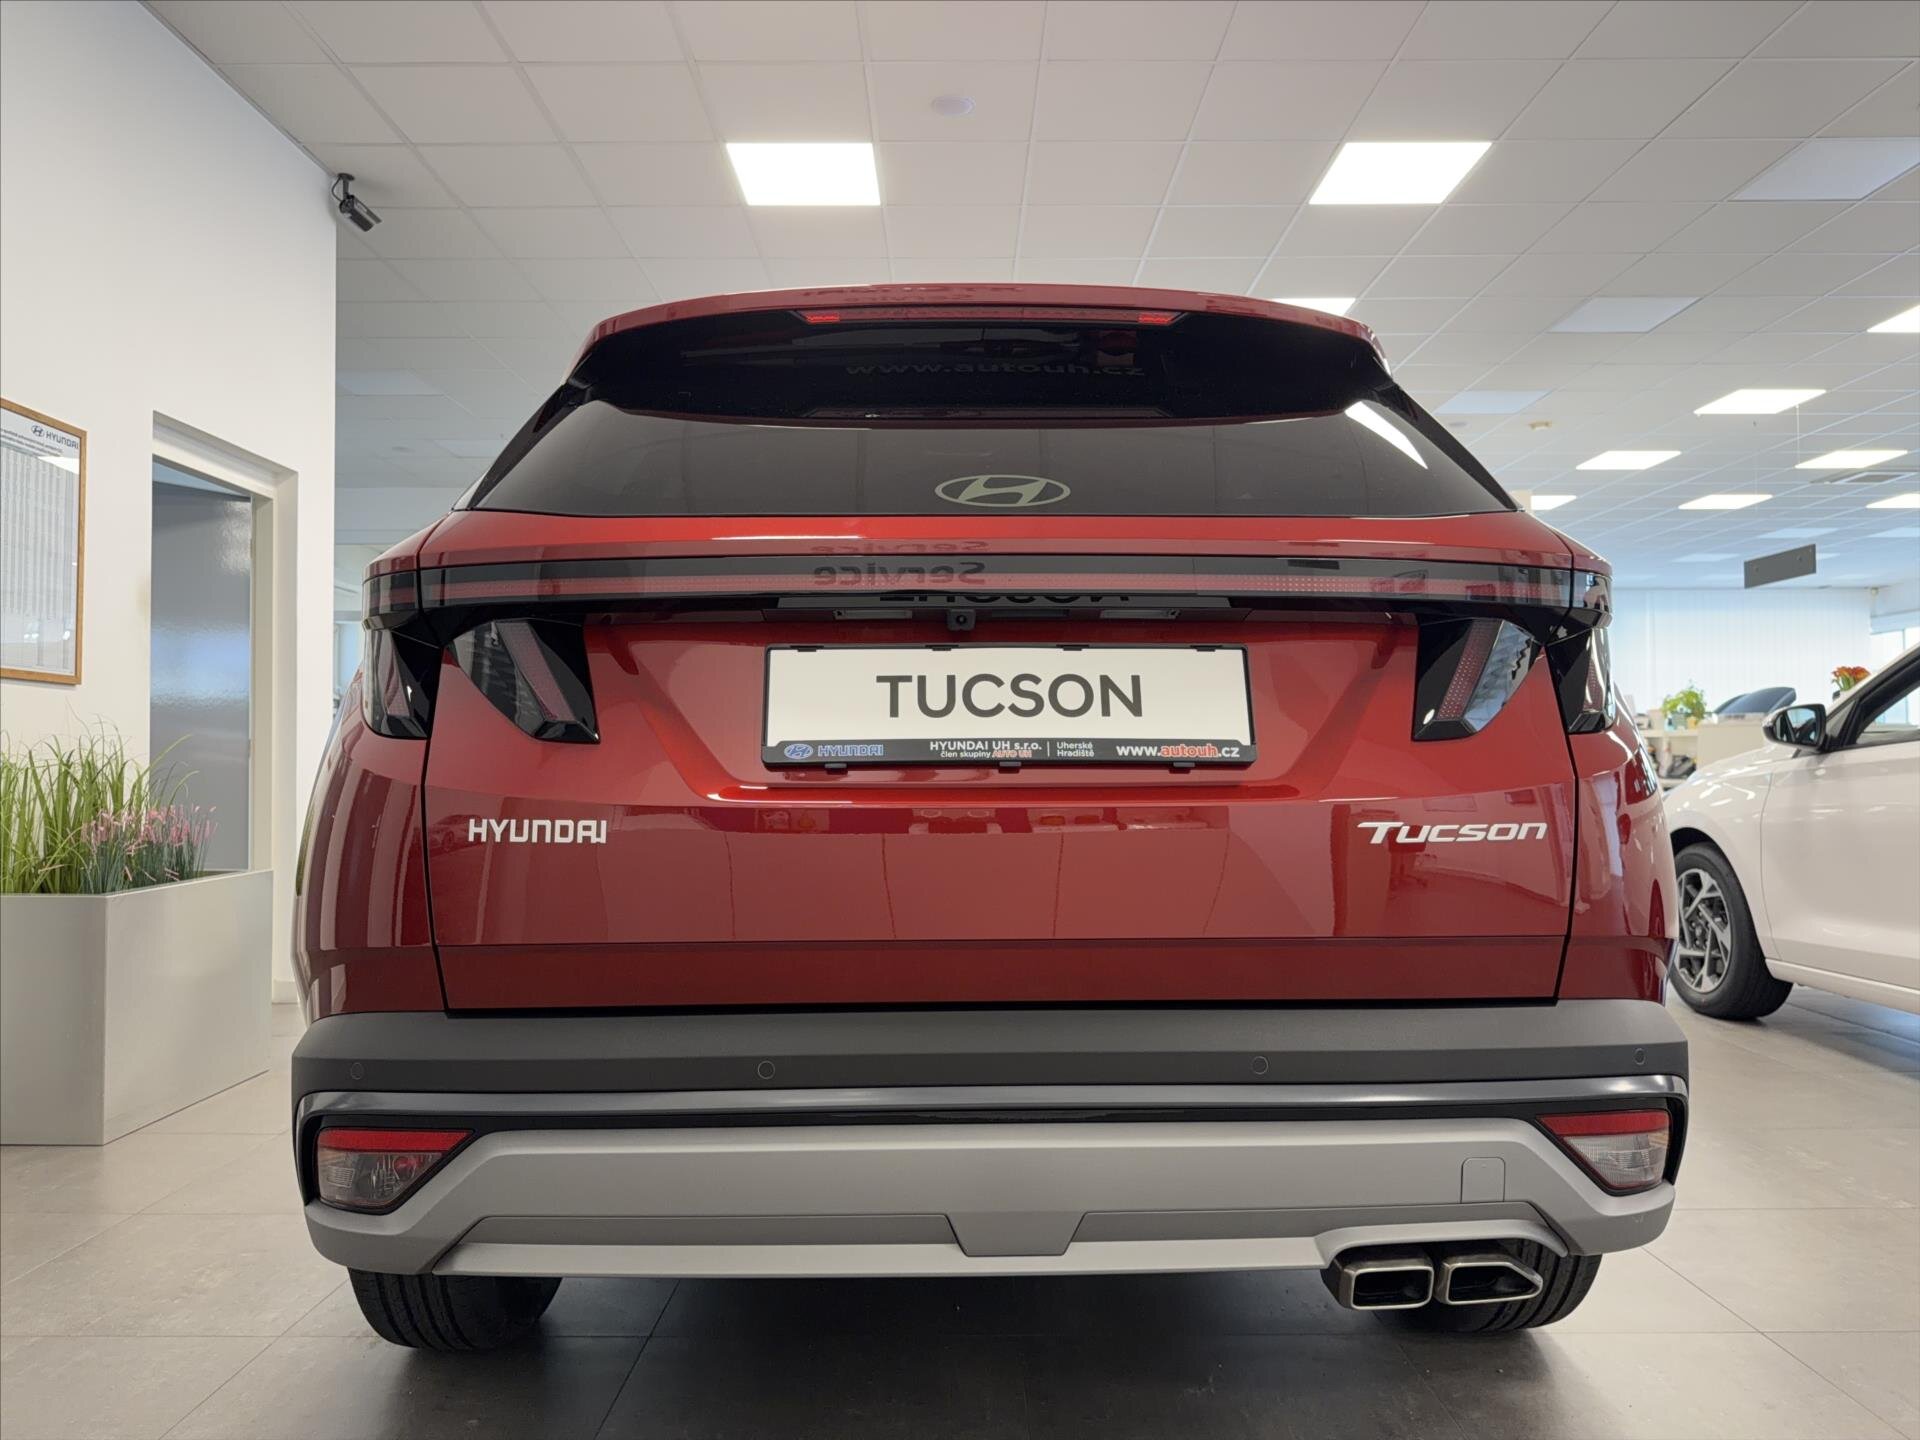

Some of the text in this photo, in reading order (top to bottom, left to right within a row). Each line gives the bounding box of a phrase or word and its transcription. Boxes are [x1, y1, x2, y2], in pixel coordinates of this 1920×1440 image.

[46, 431, 79, 449] HYUNDAI
[876, 673, 1143, 719] TUCSON
[817, 744, 884, 757] HYUNDAI
[929, 740, 1043, 751] HYUNDAI UH s.r.o.
[1056, 741, 1094, 750] Uherské
[1116, 744, 1240, 758] www.autouh.cz
[940, 750, 1033, 760] člen skupiny AUTO UH
[1056, 749, 1095, 758] Hradiště
[468, 818, 608, 844] HYUNDAI
